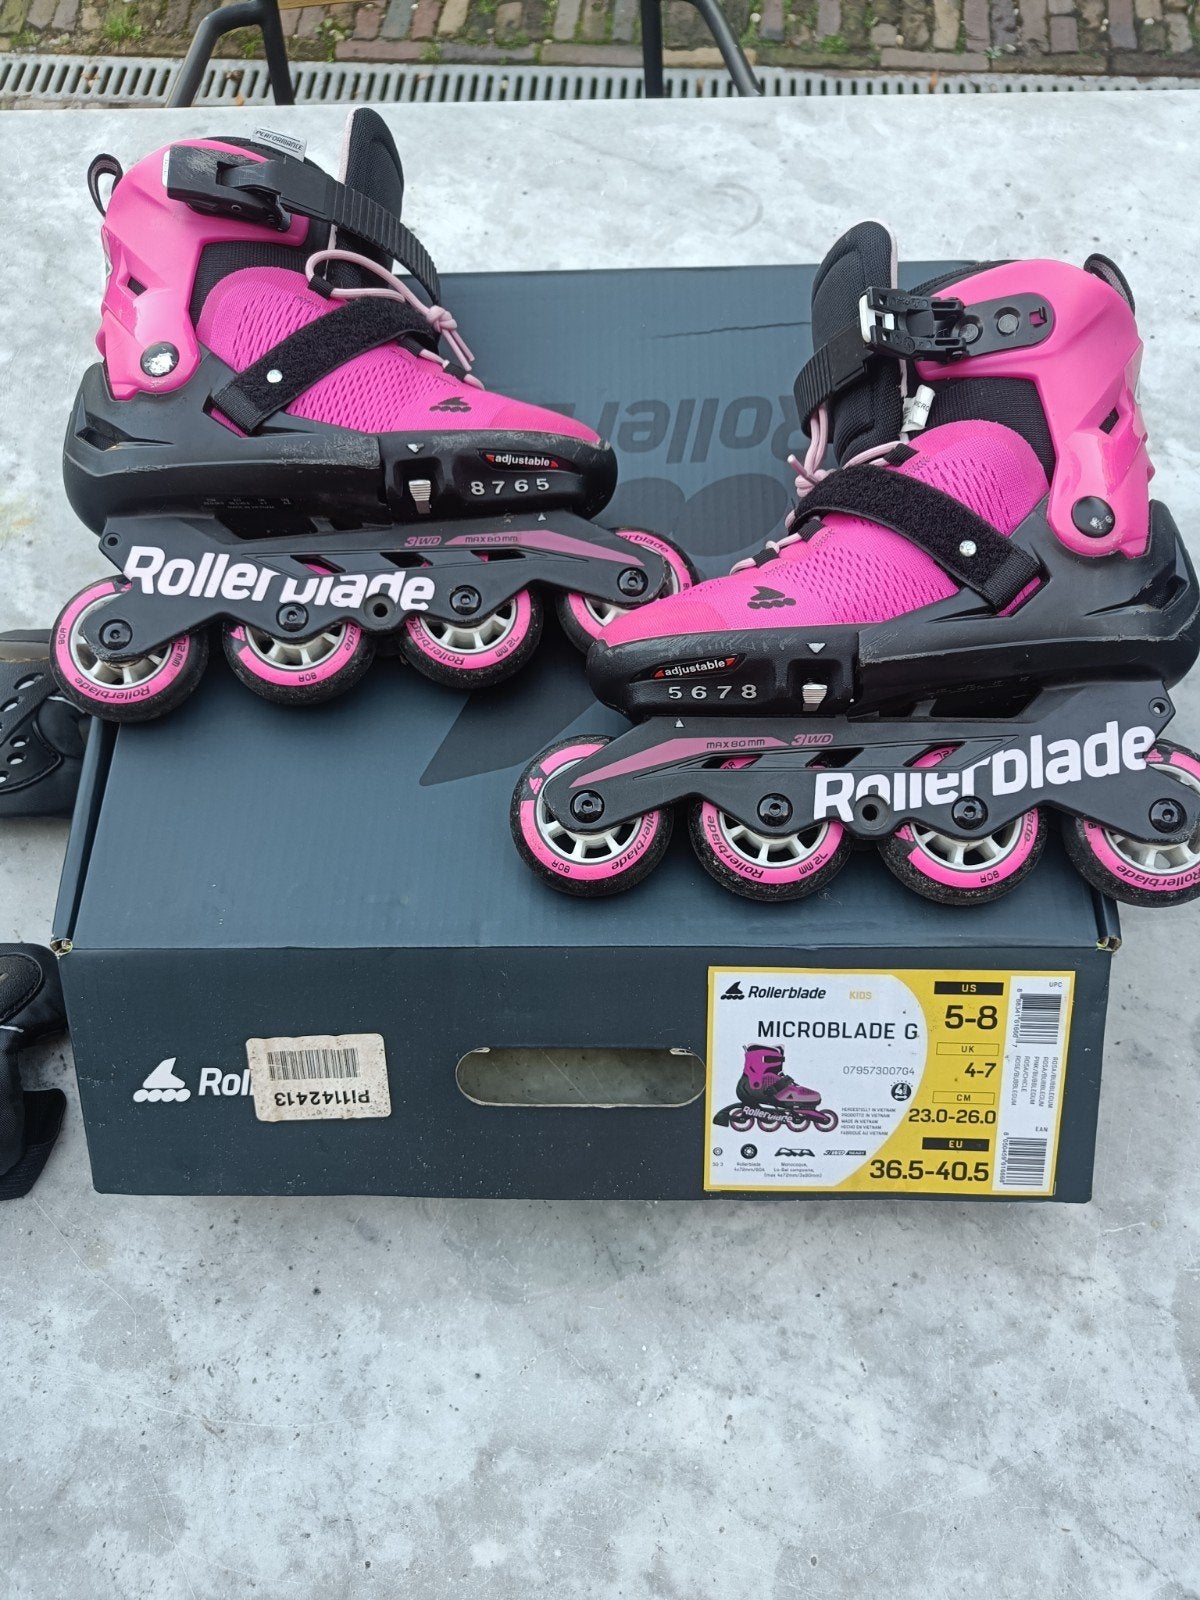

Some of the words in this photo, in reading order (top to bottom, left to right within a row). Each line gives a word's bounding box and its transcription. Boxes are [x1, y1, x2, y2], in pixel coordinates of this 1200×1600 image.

[255, 130, 303, 151] PERFORMANCE
[495, 454, 550, 467] adjustable
[470, 481, 485, 496] 8
[491, 480, 505, 495] 7
[514, 479, 529, 493] 6
[536, 478, 550, 491] 5
[123, 545, 436, 611] Rollerblade
[664, 659, 725, 677] adjustable
[75, 677, 151, 700] Rollerblade
[668, 686, 683, 700] 5
[691, 685, 707, 699] 6
[716, 685, 732, 699] 7
[741, 684, 757, 699] 8
[813, 720, 1156, 822] Rollerblade
[707, 815, 765, 879] Rollerblade
[748, 985, 827, 999] Rollerblade
[849, 991, 872, 1000] KIDS
[961, 983, 977, 993] US
[944, 1004, 998, 1030] 5-8
[757, 1020, 896, 1040] MICROBLADE
[904, 1022, 918, 1040] G
[961, 1045, 975, 1053] UK
[964, 1062, 997, 1078] 4-7
[956, 1094, 971, 1102] CM
[908, 1108, 997, 1124] 23.0-26.0
[948, 1140, 963, 1148] EU
[869, 1159, 989, 1182] 36.5-40.5
